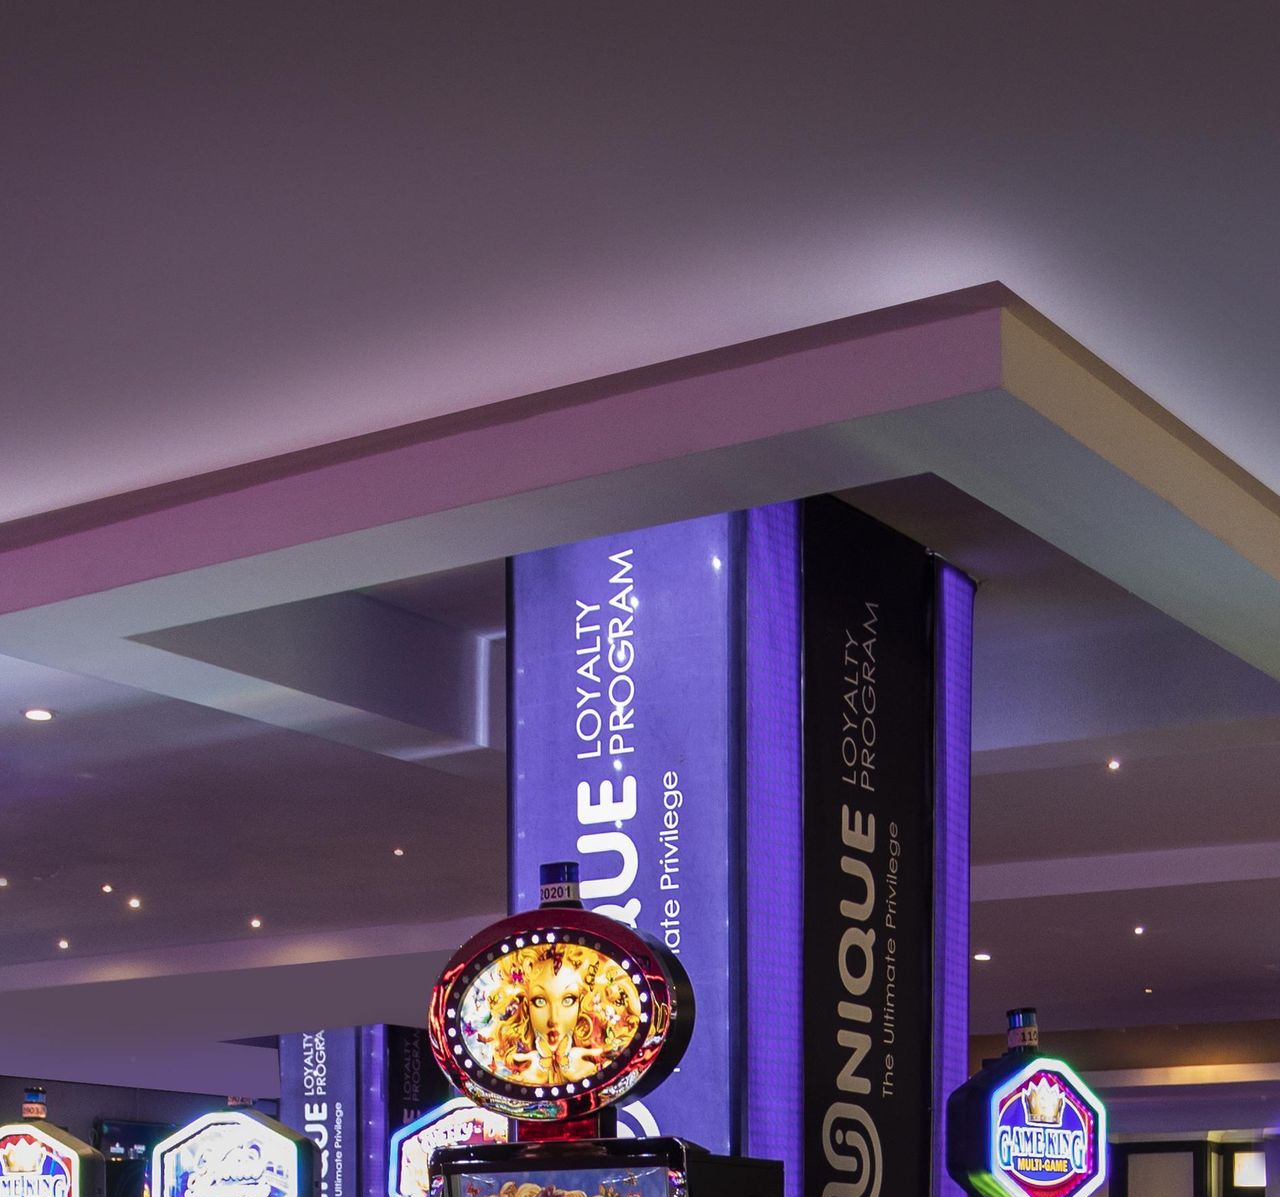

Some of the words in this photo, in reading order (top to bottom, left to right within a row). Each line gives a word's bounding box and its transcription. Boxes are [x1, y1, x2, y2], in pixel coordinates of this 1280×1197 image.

[576, 599, 603, 759] LOYALTY
[608, 548, 636, 754] PROGRAM
[842, 628, 860, 785] LOYALTY
[861, 601, 880, 792] PROGRAM
[659, 770, 685, 890] Privilege
[885, 821, 902, 929] Privilege
[882, 937, 897, 1045] Ultimate
[303, 1033, 314, 1096] LOYALTY
[315, 1029, 327, 1096] PROGRA
[403, 1037, 412, 1100] LOYALTY
[882, 1053, 895, 1099] The
[334, 1102, 344, 1150] Privilege
[999, 1126, 1044, 1170] GAME
[1046, 1127, 1087, 1173] KING
[1017, 1158, 1069, 1173] MULTI-GAME
